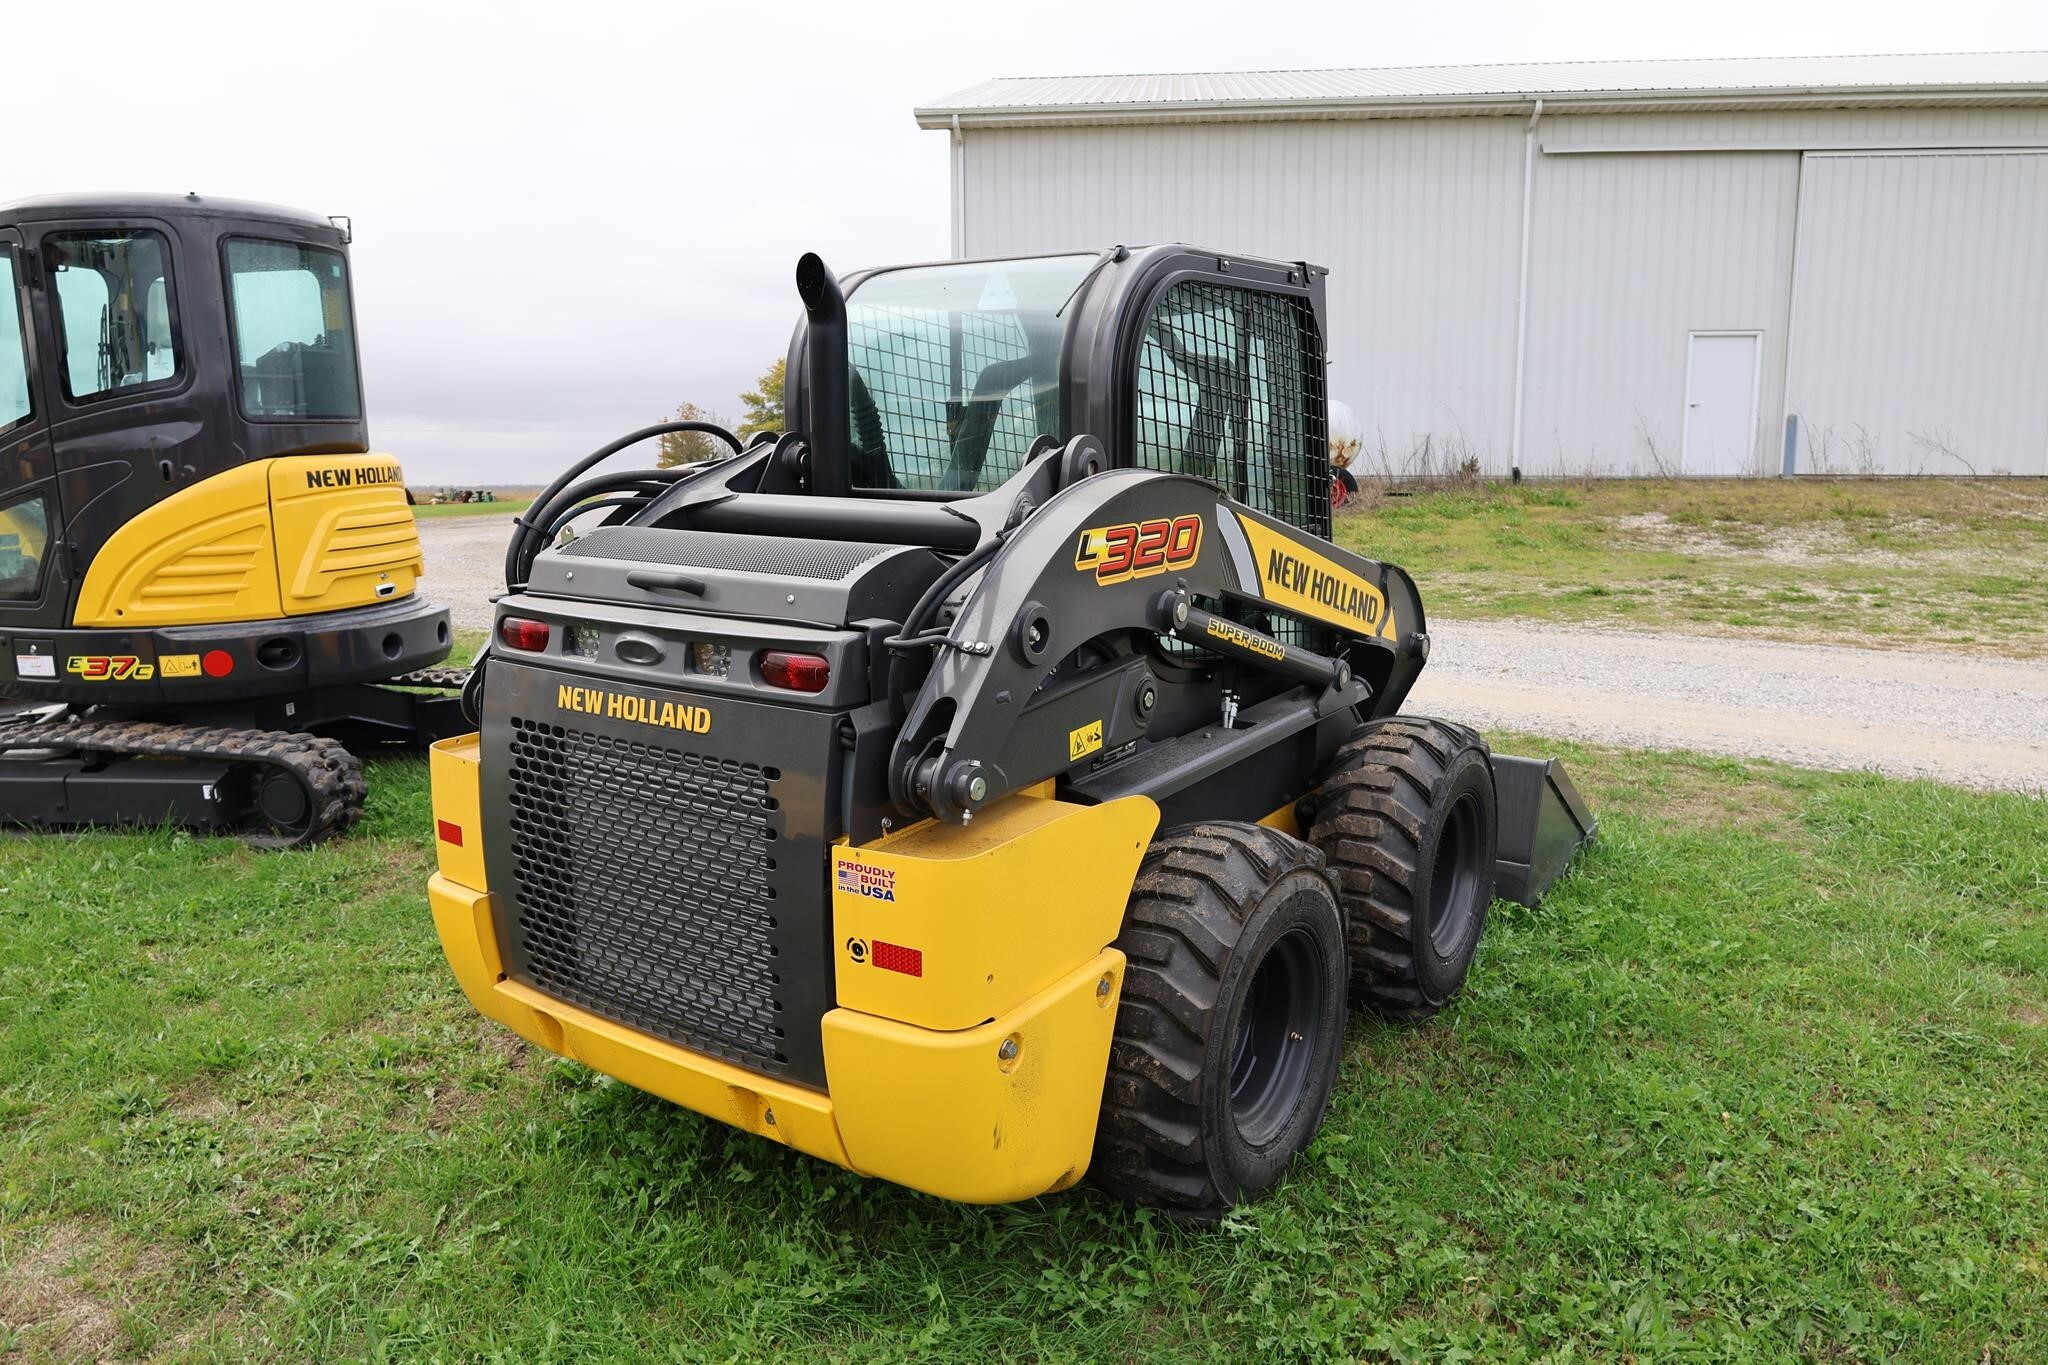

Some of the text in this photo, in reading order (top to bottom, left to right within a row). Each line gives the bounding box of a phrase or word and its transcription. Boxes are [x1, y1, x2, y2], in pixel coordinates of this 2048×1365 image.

[306, 466, 401, 488] NEW HOLLAND
[1077, 515, 1201, 580] L320
[1267, 548, 1378, 625] NEW HOLLAND
[1208, 618, 1285, 659] SUPER BOOM
[557, 684, 712, 734] NEW HOLLAND
[838, 860, 896, 879] PROUDLY
[860, 874, 896, 889] BUILT
[846, 886, 860, 894] the
[860, 884, 896, 902] USA
